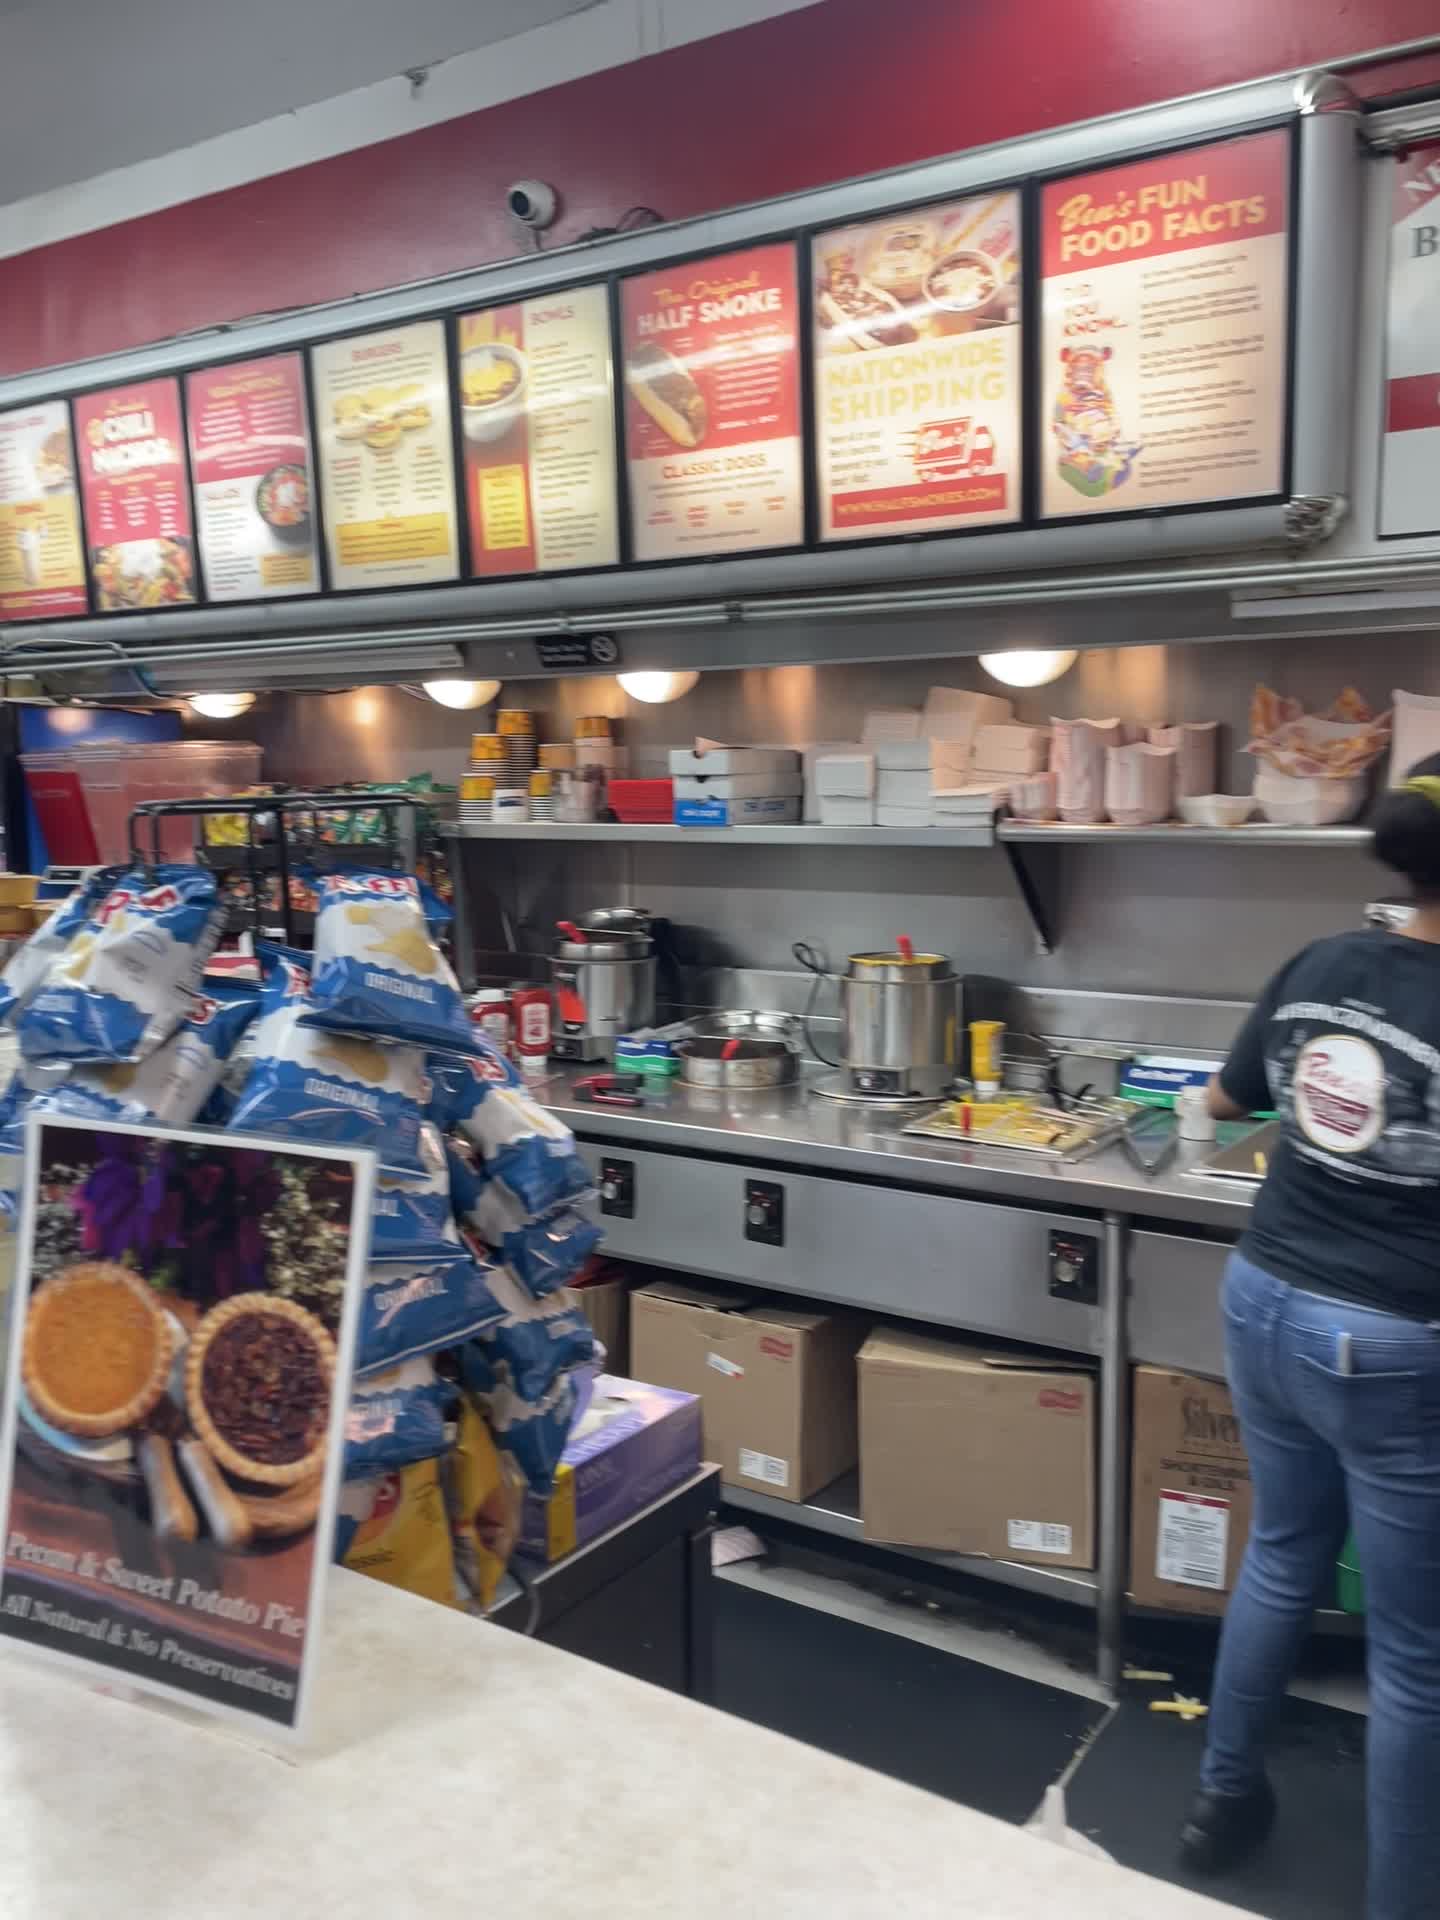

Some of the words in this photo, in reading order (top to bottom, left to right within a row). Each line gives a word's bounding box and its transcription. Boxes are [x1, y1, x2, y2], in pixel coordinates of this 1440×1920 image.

[1056, 191, 1136, 232] Ben's
[1138, 175, 1208, 214] FUN
[1061, 219, 1152, 262] FOOD
[1162, 195, 1267, 241] FACTS
[637, 303, 696, 335] HALF
[698, 286, 782, 324] SMOKE
[827, 336, 1006, 387] NATIONWIDE
[828, 371, 1006, 425] SHIPPING
[6, 1531, 76, 1574] Pecan
[102, 1557, 173, 1601] Sweet
[176, 1578, 261, 1625] Potato
[262, 1602, 305, 1638] Pie
[29, 1601, 111, 1641] Natural
[128, 1629, 160, 1658] No
[159, 1639, 296, 1701] Preservatives
